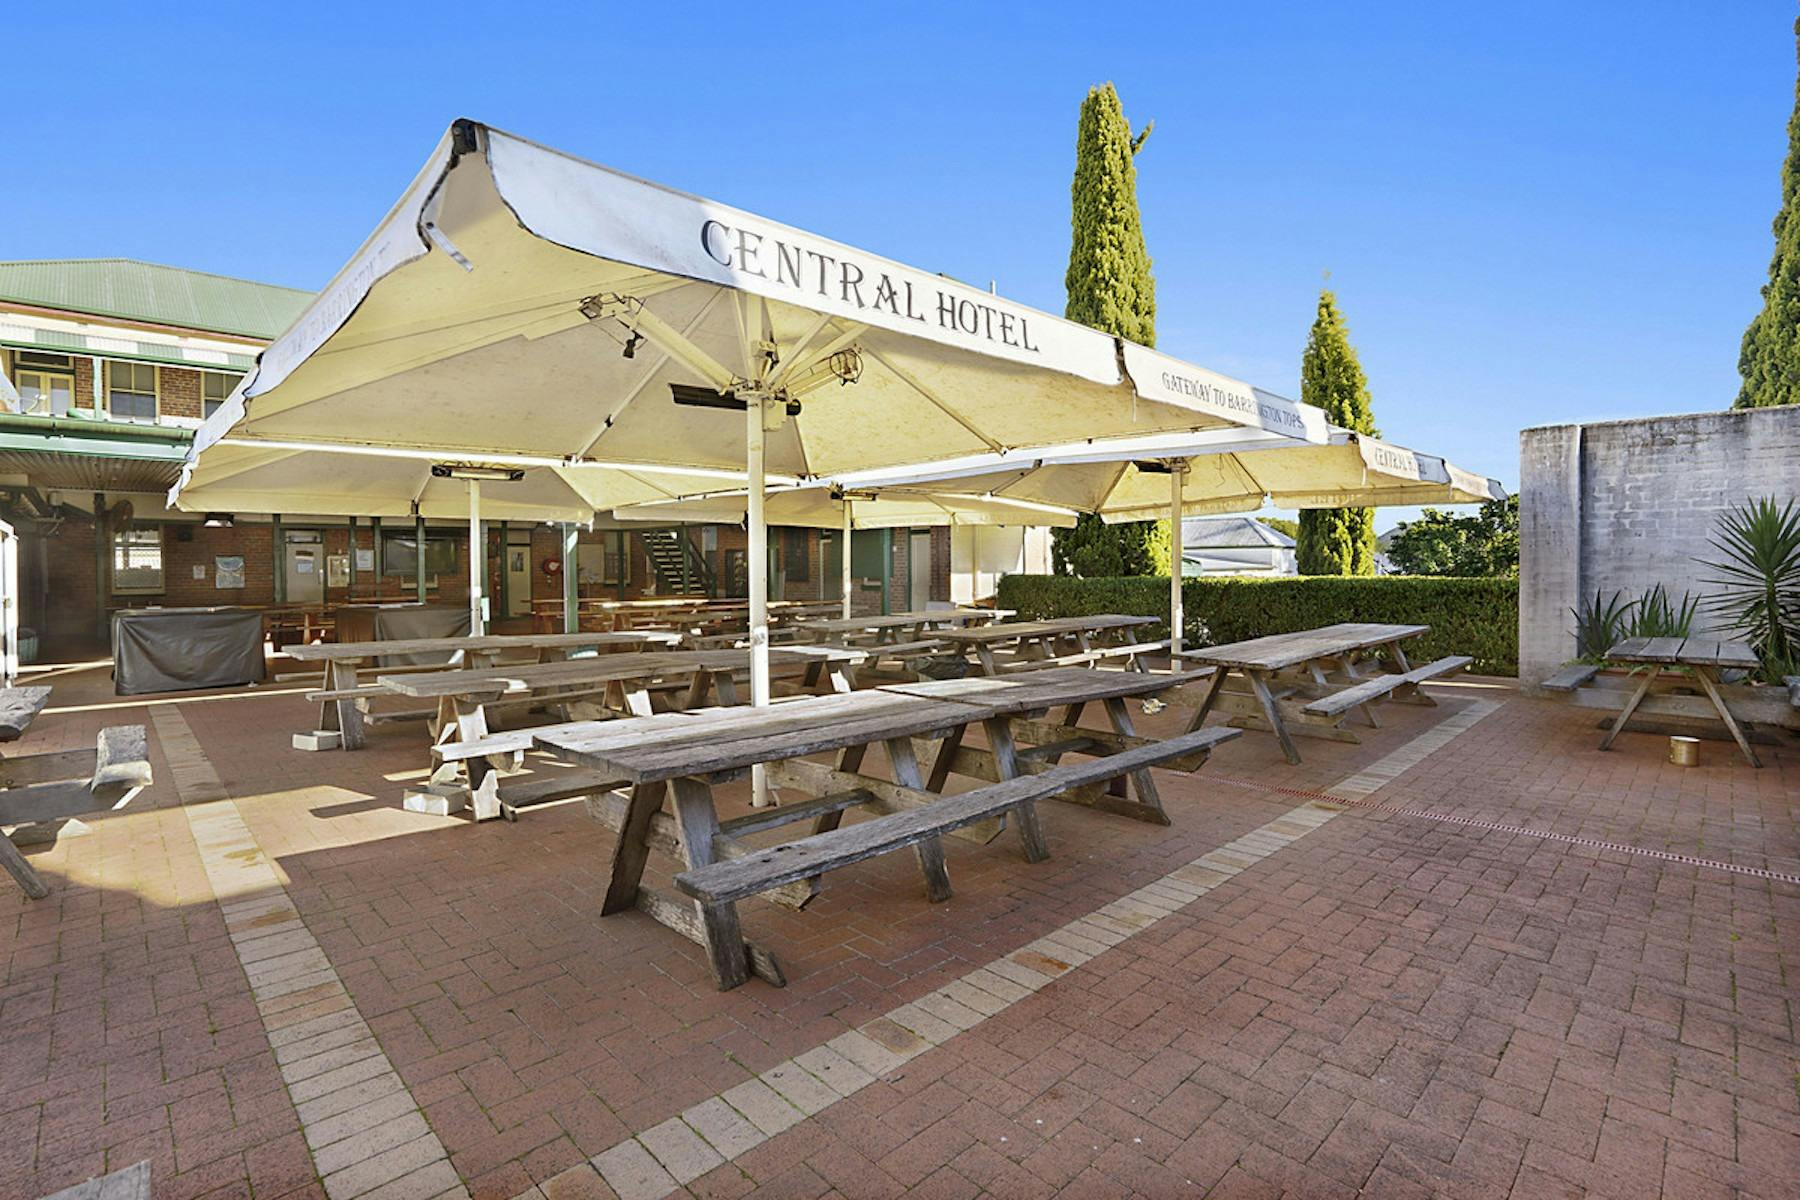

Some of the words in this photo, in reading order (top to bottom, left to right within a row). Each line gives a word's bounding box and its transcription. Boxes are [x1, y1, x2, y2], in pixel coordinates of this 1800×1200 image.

[700, 219, 926, 322] CENTRAL
[936, 290, 1040, 353] HOTEL
[1161, 371, 1212, 403] GATEWAY
[1213, 387, 1227, 407] TO
[1228, 392, 1283, 424] BARRGTON
[1282, 409, 1305, 429] TOPS
